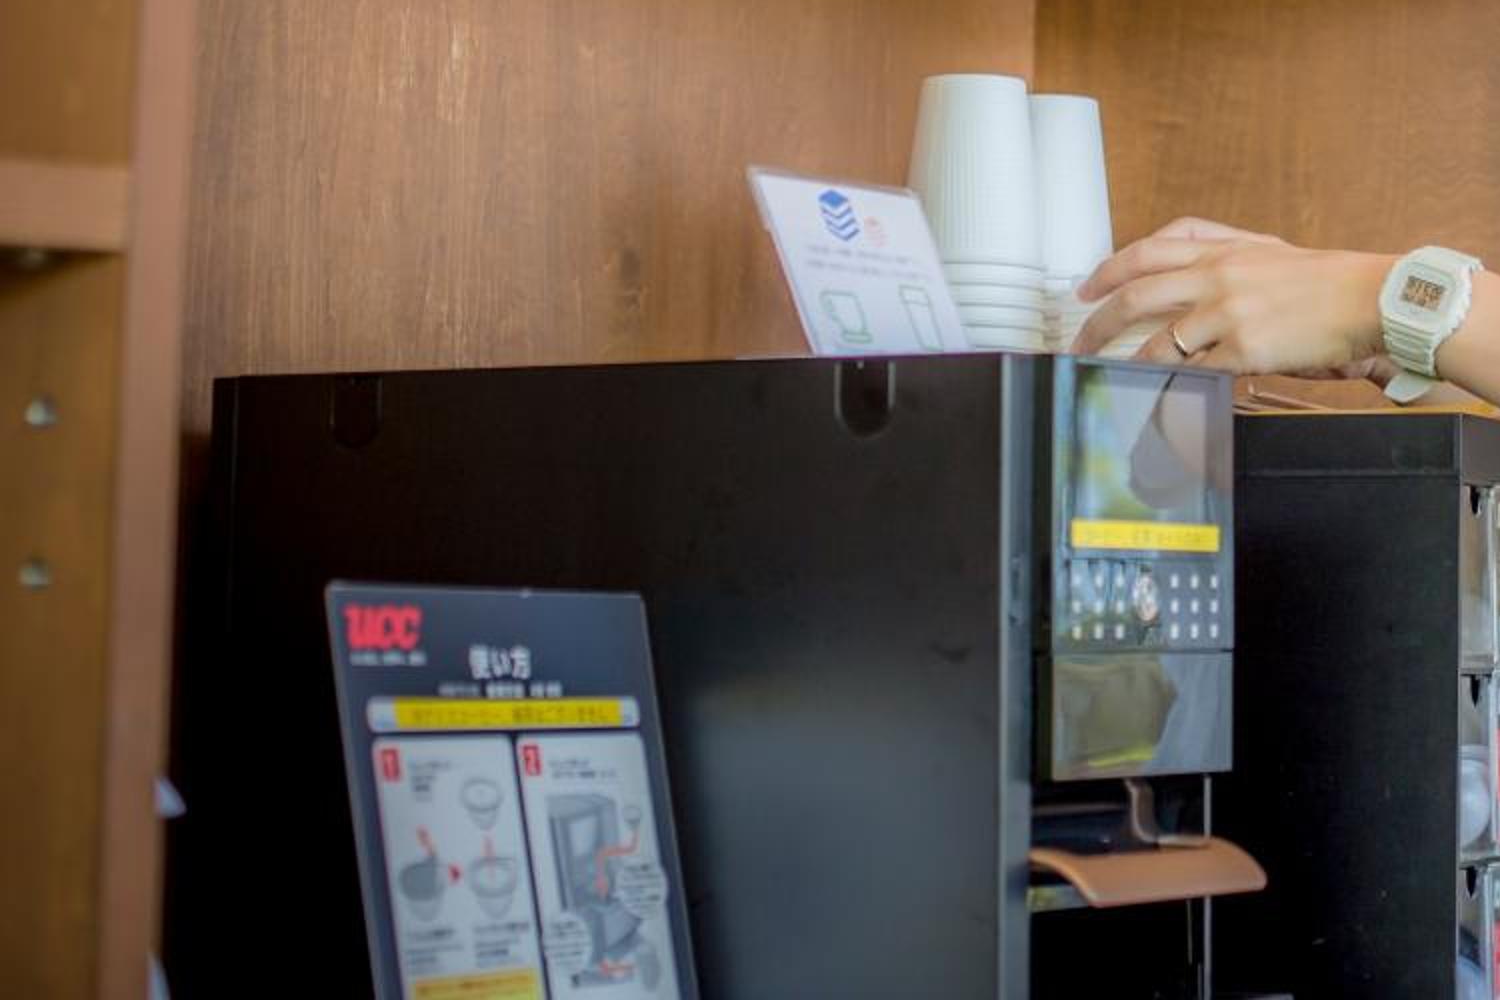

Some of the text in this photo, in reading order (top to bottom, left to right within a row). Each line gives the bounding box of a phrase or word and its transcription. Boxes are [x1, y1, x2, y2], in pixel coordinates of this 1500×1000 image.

[345, 605, 421, 650] UCC
[468, 643, 532, 680] 使い方
